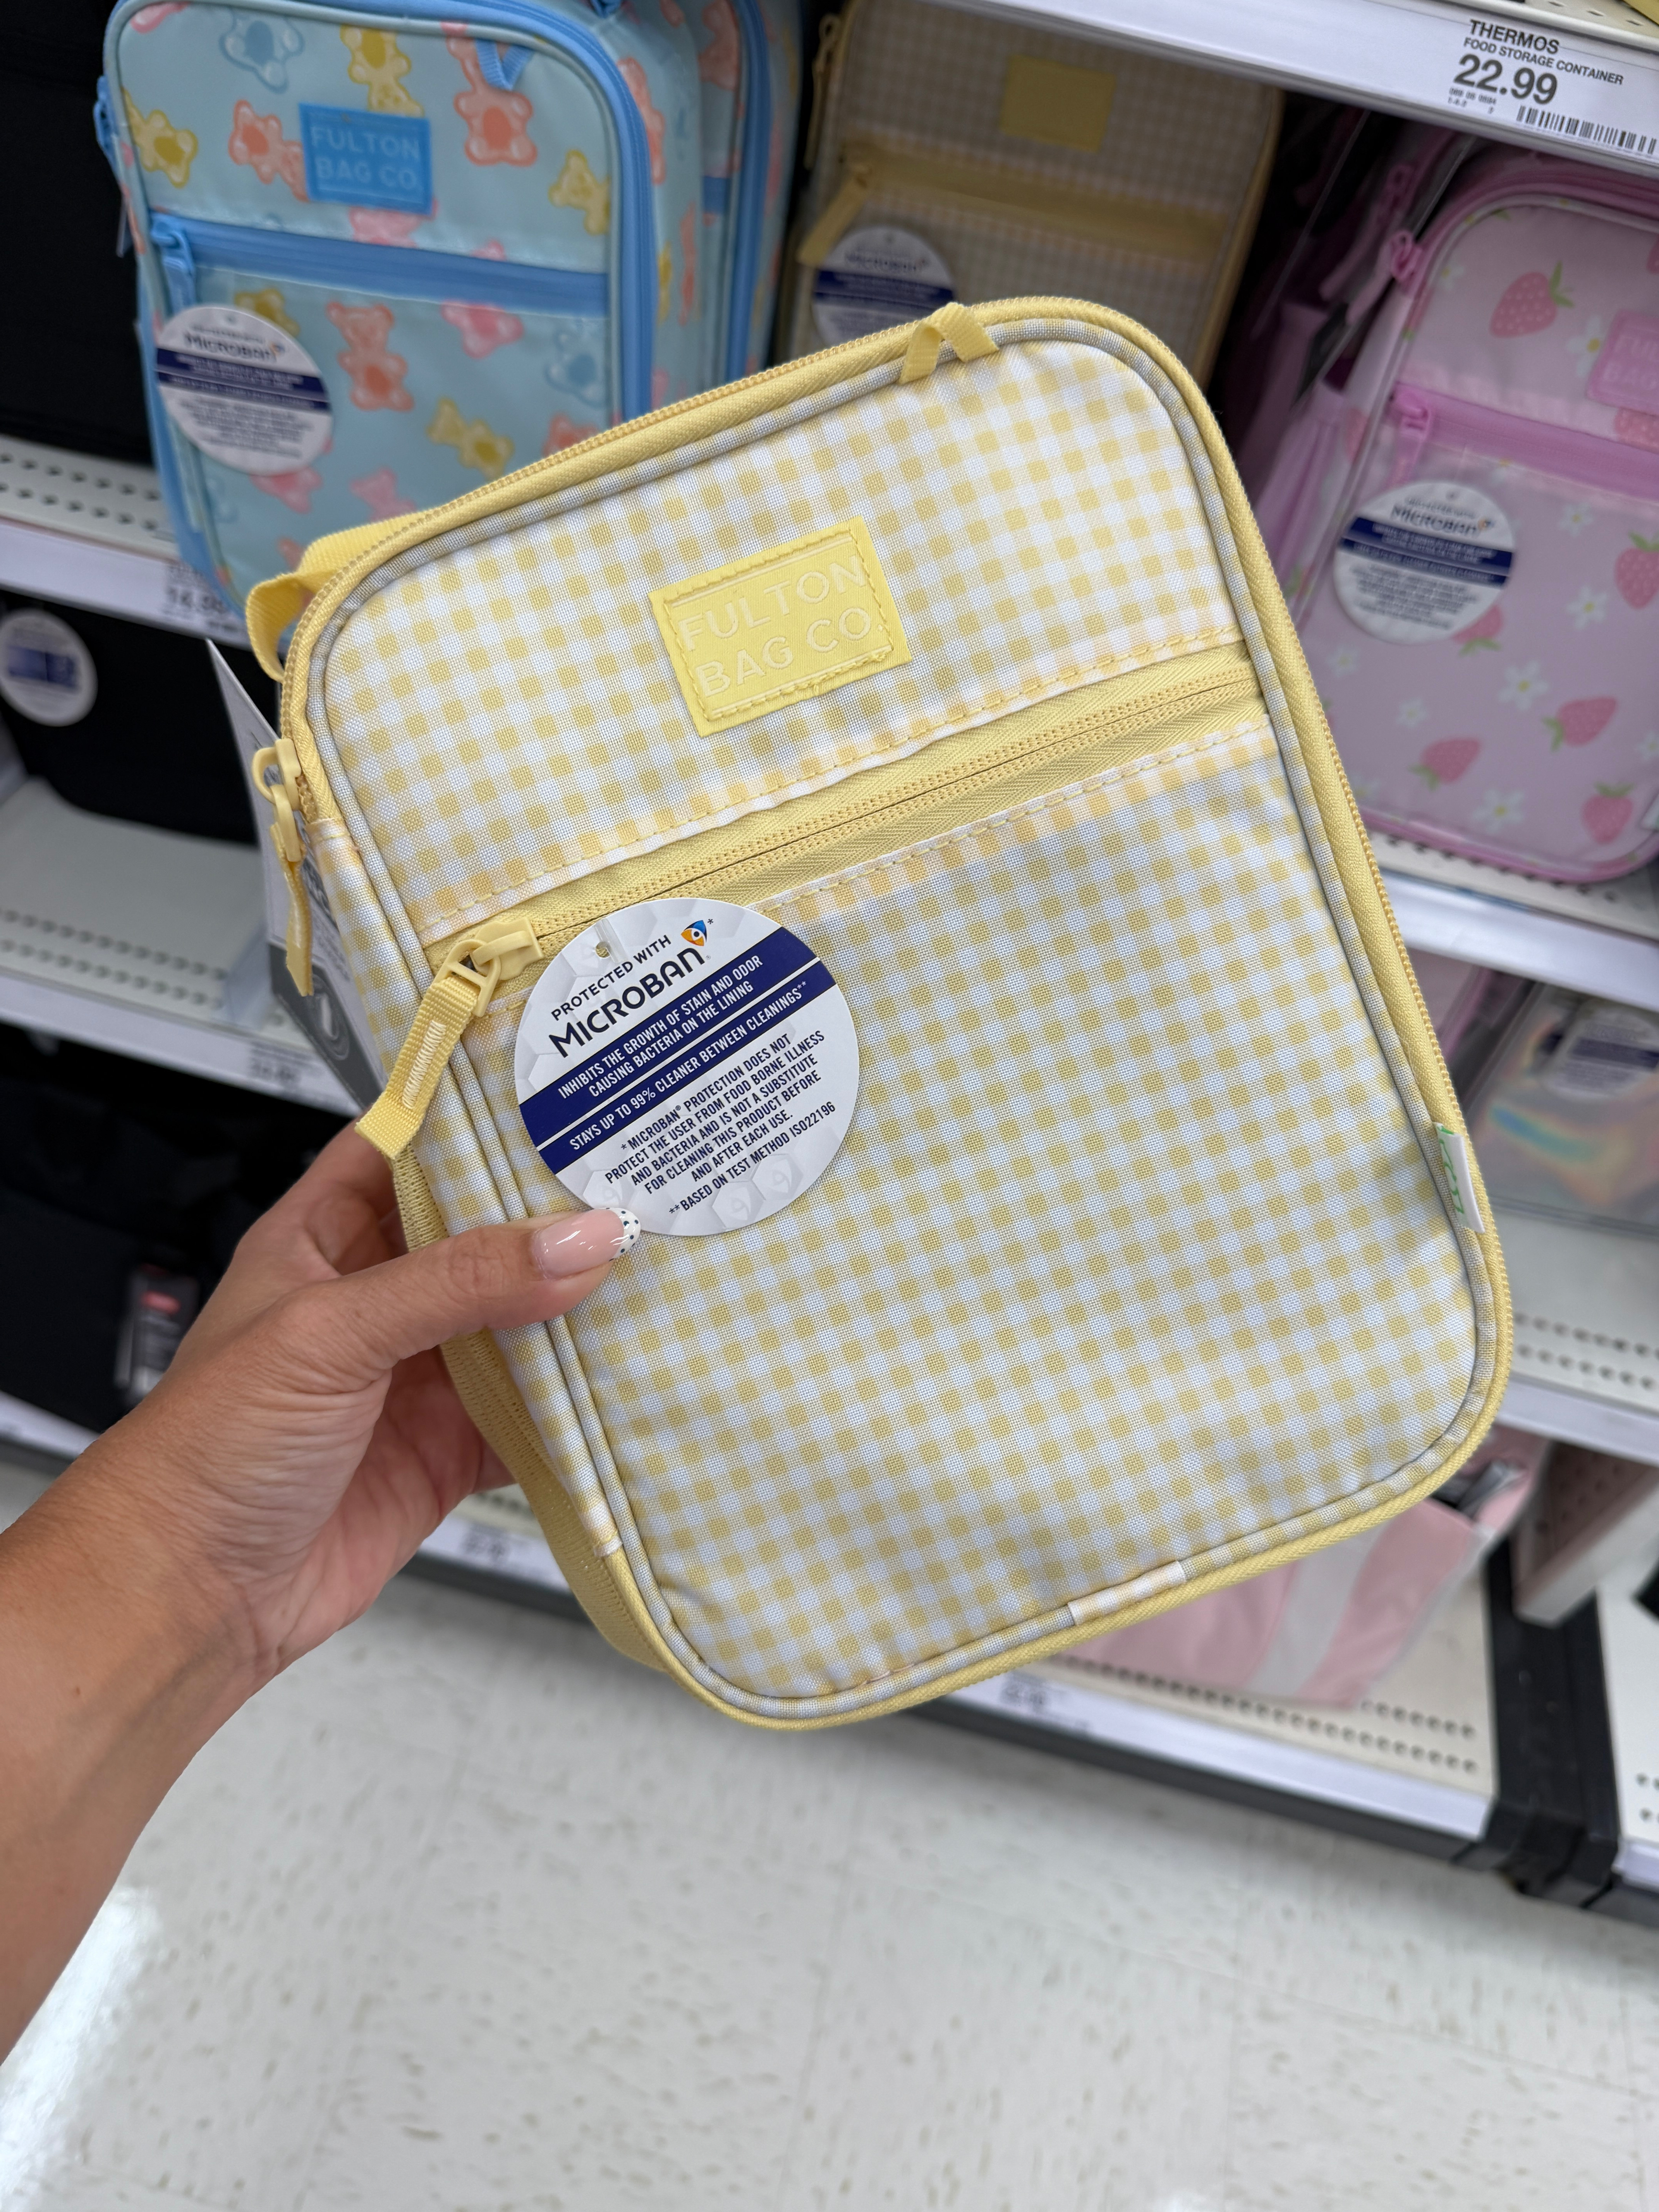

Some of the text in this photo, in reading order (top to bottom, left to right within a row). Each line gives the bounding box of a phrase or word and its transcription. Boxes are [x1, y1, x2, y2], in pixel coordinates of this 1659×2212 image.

[1453, 53, 1558, 104] 22.99
[1464, 37, 1624, 85] FOOD STORAGE CONTAINER
[1470, 19, 1559, 54] THERMOS
[311, 126, 420, 161] FULTON
[315, 156, 372, 184] BAG
[679, 555, 867, 651] FULTON
[694, 608, 884, 697] BAG CO.
[548, 947, 705, 1058] MICROBAN
[551, 934, 672, 1022] PROTECTED WITH
[558, 955, 763, 1099] INHIBITS THE GROWTH OF STAIN AND ODOR
[589, 981, 754, 1097] CAUSING BACTERIA ON THE LINING
[570, 1124, 602, 1150] STAYS
[599, 1113, 615, 1129] UP
[615, 1103, 632, 1119] TO
[630, 1087, 656, 1109] 99%
[654, 1057, 701, 1092] CLEANER
[699, 1024, 748, 1063] BETWEEN
[604, 1030, 825, 1184] PROTECT THE USER FROM FOOD BORNE ILLNESS
[683, 1065, 745, 1113] PROTECTION
[742, 1048, 771, 1072] DOES
[769, 1033, 791, 1054] NOT
[630, 1053, 818, 1186] AND BACTERIA AND IS NOT A SUBSTITUTE
[644, 1069, 822, 1195] FOR CLEANING THIS PRODUCT BEFORE
[690, 1109, 793, 1182] AND AFTER EACH USE.
[711, 1173, 729, 1189] ON
[725, 1157, 751, 1179] TEST
[749, 1132, 790, 1164] METHOD
[788, 1101, 836, 1138] ISO22196
